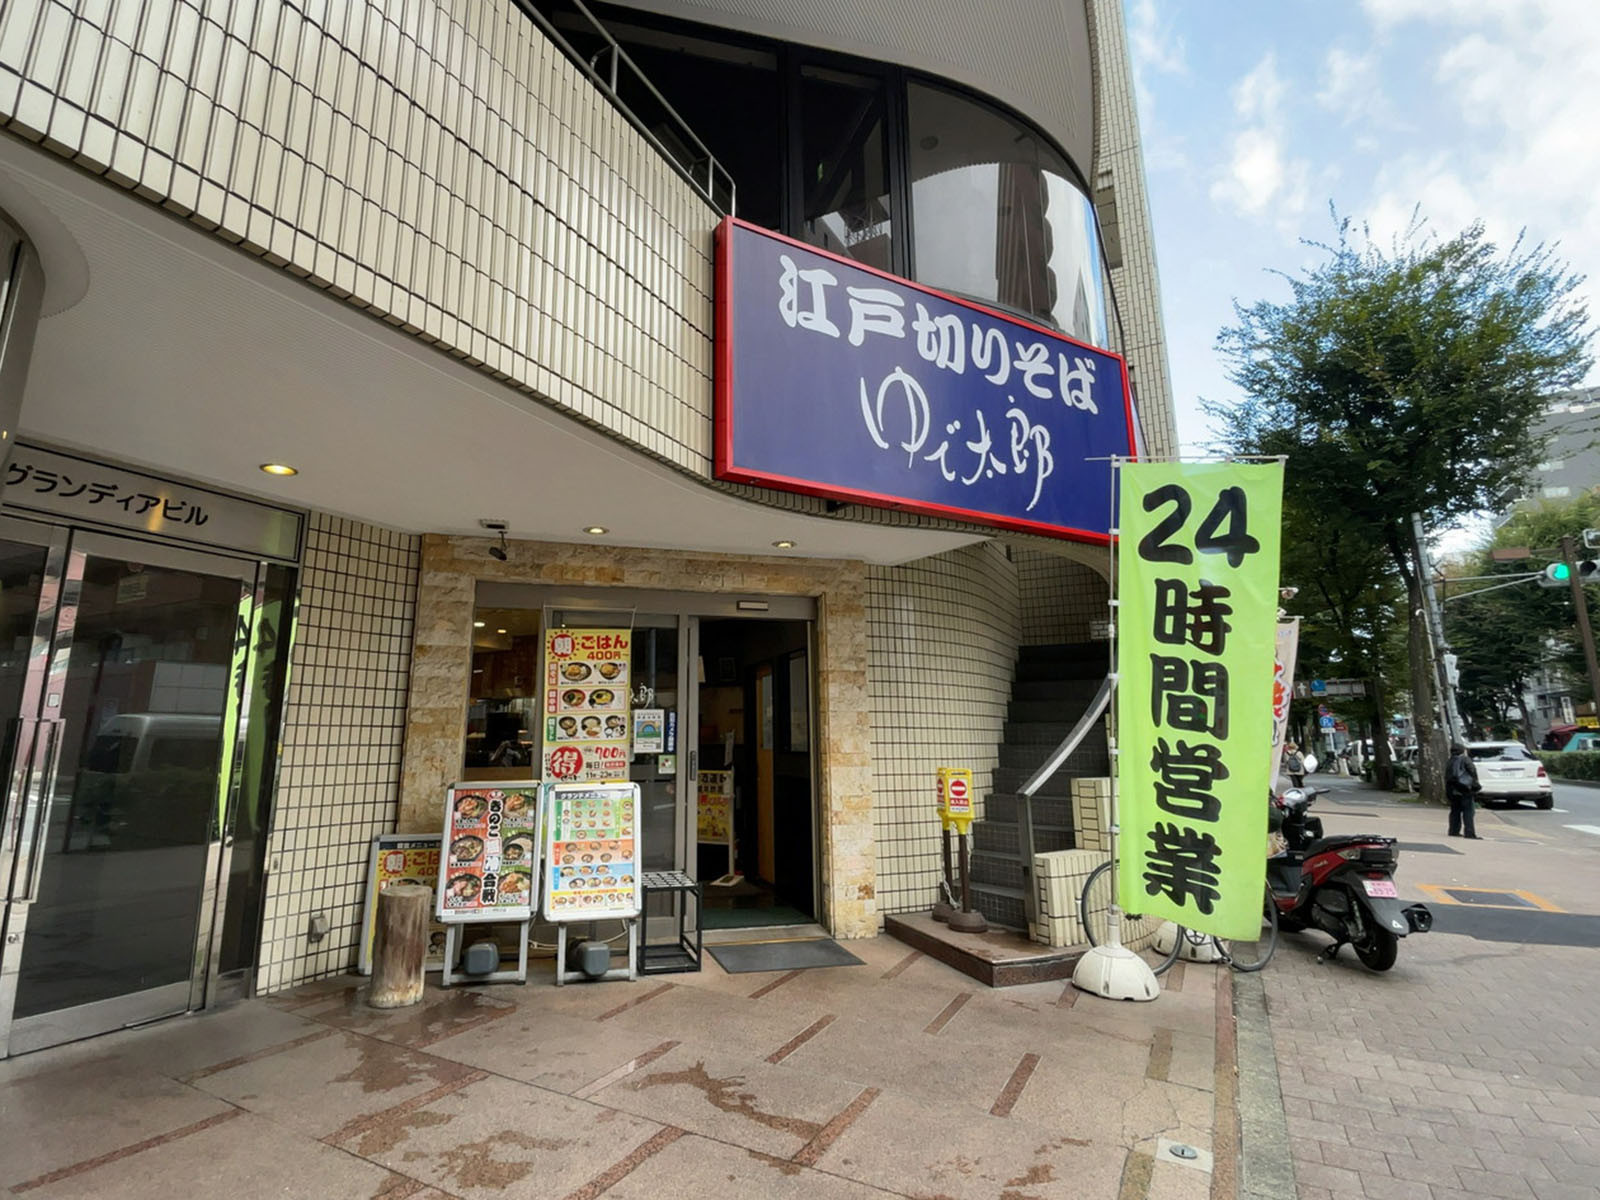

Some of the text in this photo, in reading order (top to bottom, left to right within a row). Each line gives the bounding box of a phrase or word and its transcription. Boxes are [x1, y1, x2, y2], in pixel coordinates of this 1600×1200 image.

[778, 254, 1099, 415] 江戸切りそば
[860, 366, 1054, 512] ゆで太郎
[6, 463, 208, 526] グランディアビル
[552, 751, 578, 776] 得
